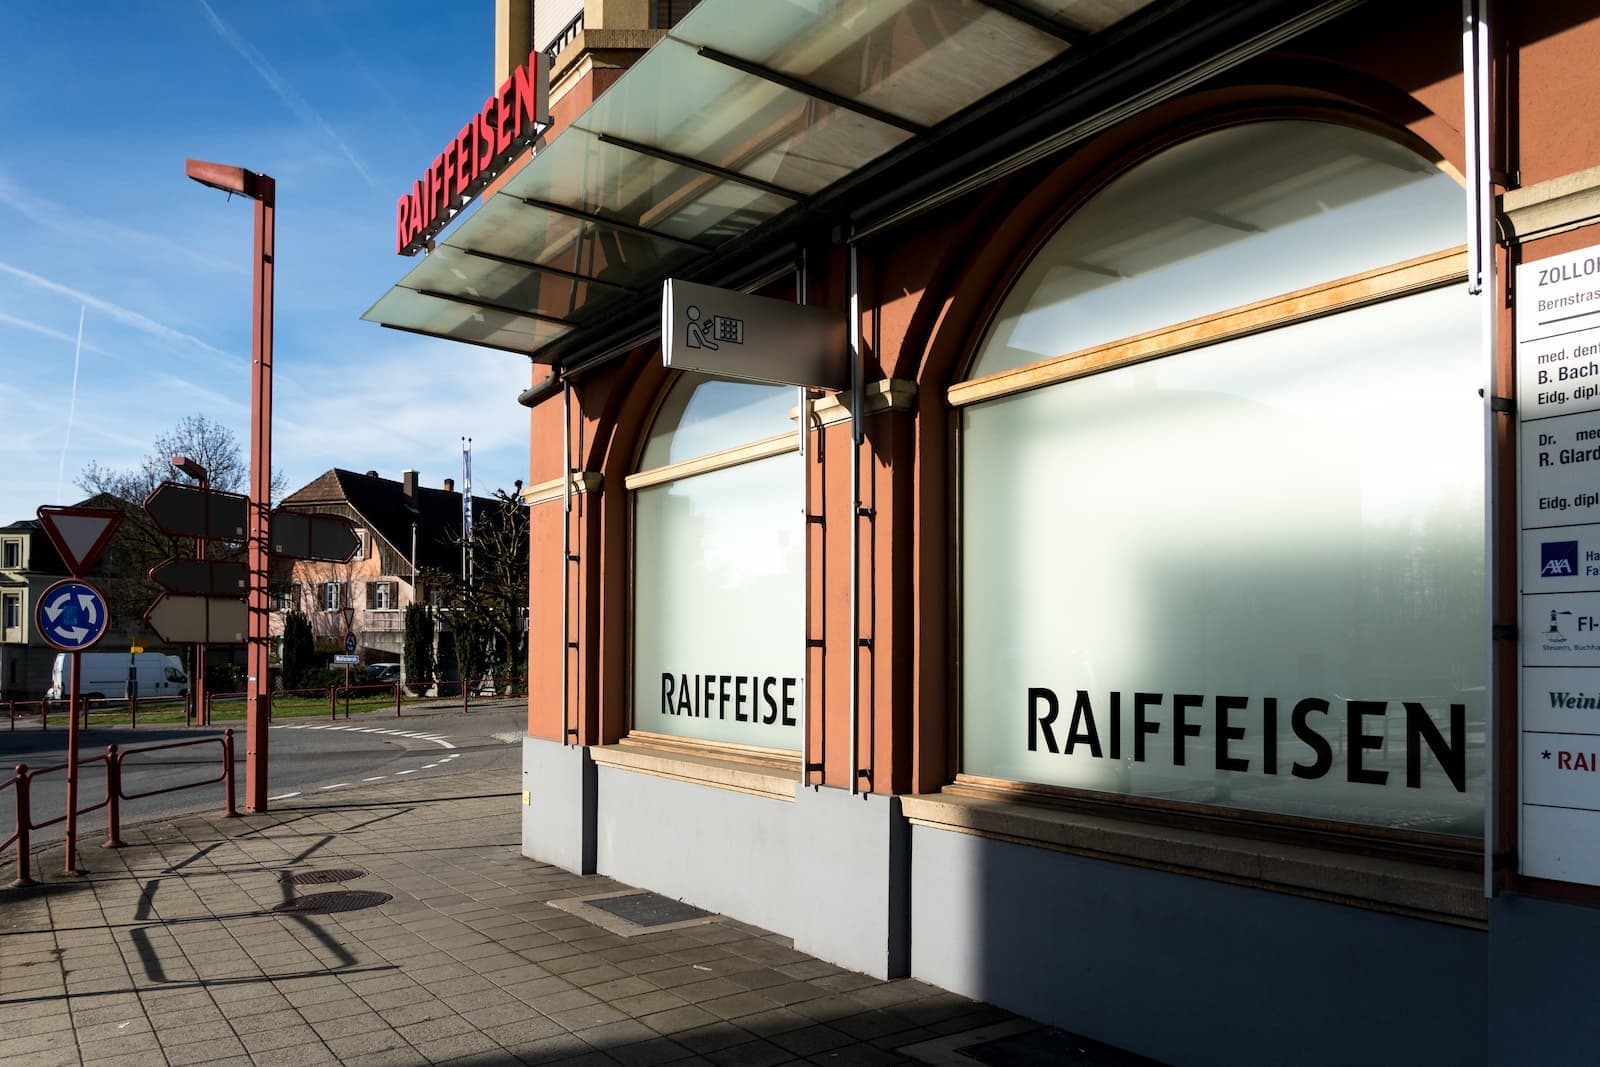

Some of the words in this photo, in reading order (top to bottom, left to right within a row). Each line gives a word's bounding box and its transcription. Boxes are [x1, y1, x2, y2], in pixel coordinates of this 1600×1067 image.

[396, 50, 538, 255] RAIFFEISEN
[1538, 348, 1569, 364] med.
[1538, 370, 1553, 385] B.
[1558, 361, 1599, 381] Bach
[1538, 390, 1569, 405] Eidg.
[1539, 434, 1557, 446] Dr.
[1539, 452, 1554, 467] R.
[1539, 496, 1571, 511] Eidg.
[1541, 559, 1572, 574] AXA
[661, 672, 804, 726] RAIFFEISE
[1027, 687, 1466, 793] RAIFFEISEN
[1557, 751, 1597, 772] RAI
